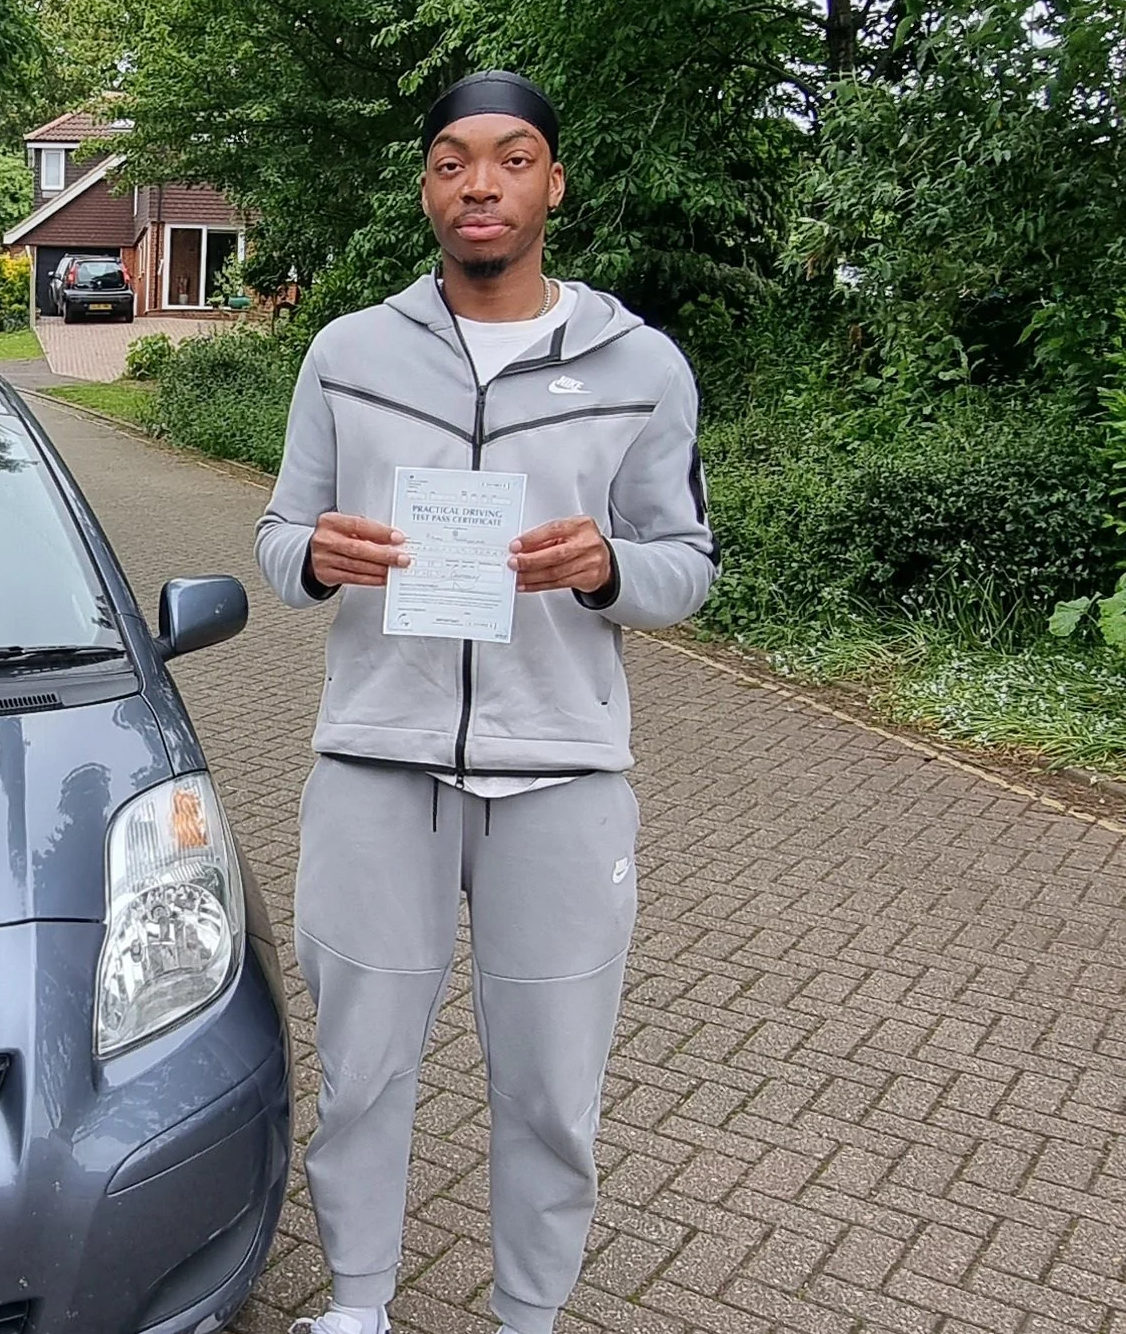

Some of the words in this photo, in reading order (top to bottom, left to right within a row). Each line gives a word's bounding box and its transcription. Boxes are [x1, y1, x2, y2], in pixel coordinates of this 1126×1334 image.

[412, 505, 459, 516] PRACTICAL
[462, 507, 503, 518] DRIVING
[412, 513, 429, 522] TEST
[431, 514, 451, 523] PASS
[452, 516, 502, 526] CERTIFICATE
